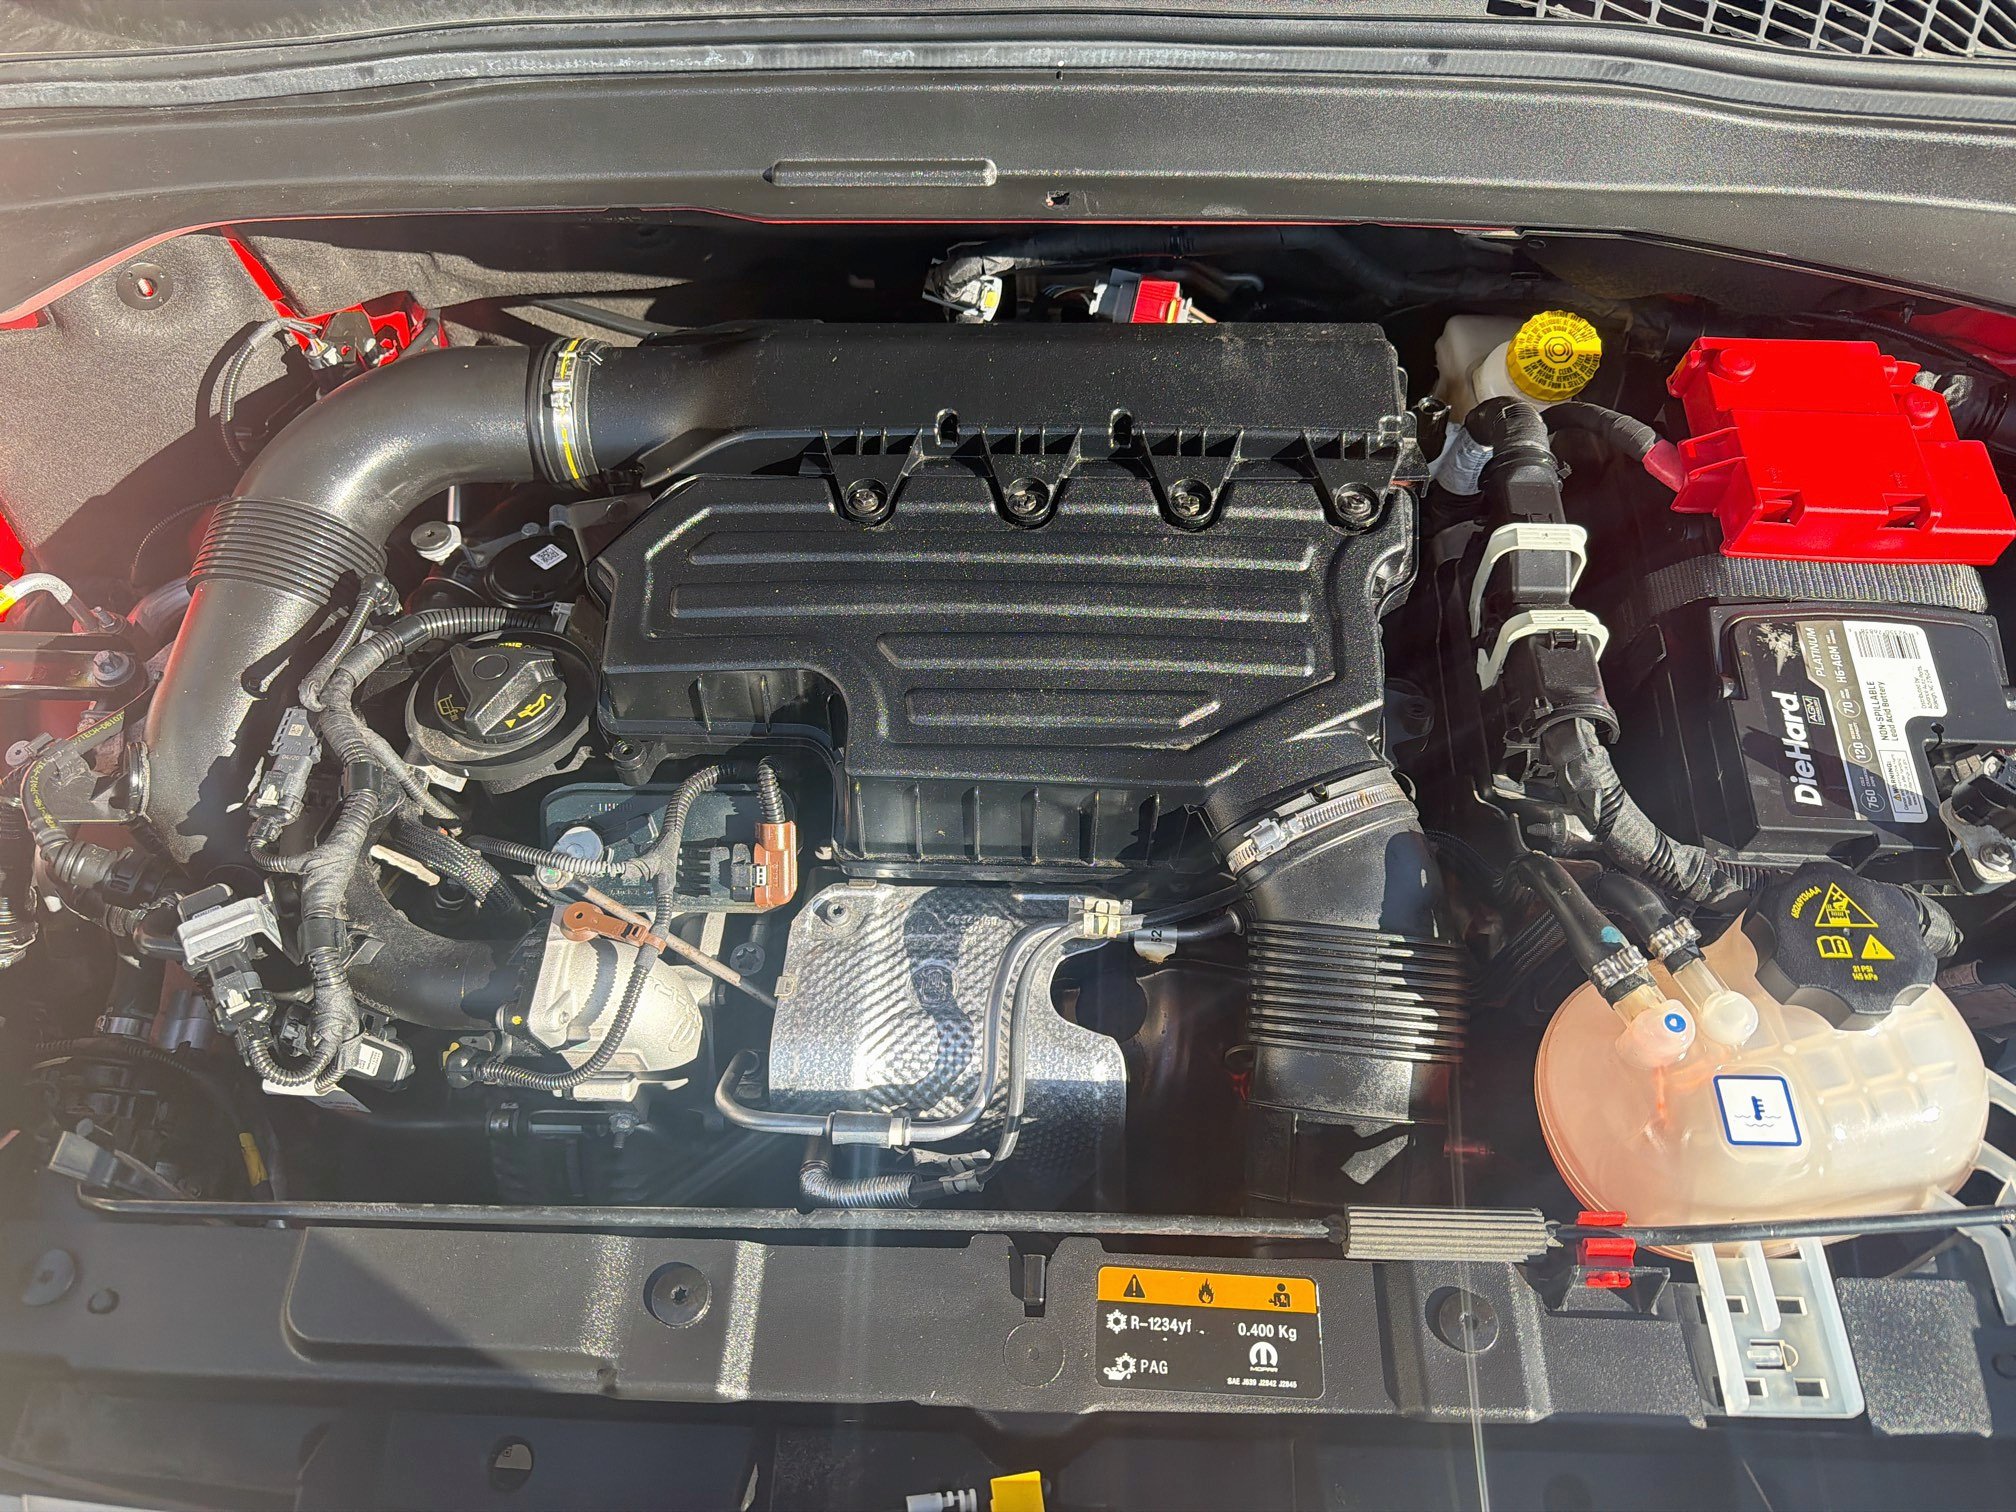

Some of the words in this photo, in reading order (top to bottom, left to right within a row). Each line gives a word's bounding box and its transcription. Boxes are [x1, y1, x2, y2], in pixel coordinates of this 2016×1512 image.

[1805, 627, 1826, 677] PLATINUM
[1828, 646, 1848, 683] H6-AGM
[1878, 681, 1890, 707] Battery
[1804, 698, 1818, 722] AGM
[1842, 701, 1856, 714] 70
[1866, 681, 1889, 741] NON-SPILLABLE
[1883, 708, 1893, 722] Acid
[1887, 724, 1899, 741] Lead
[1771, 691, 1823, 807] DieHard
[1853, 742, 1867, 760] 120
[1865, 789, 1880, 808] 760
[1861, 965, 1874, 973] PSI
[1130, 1315, 1192, 1336] R-1234yf
[1237, 1322, 1275, 1338] 0.400
[1278, 1324, 1297, 1342] Kg
[1140, 1359, 1169, 1375] PAG
[1226, 1376, 1240, 1385] SAE
